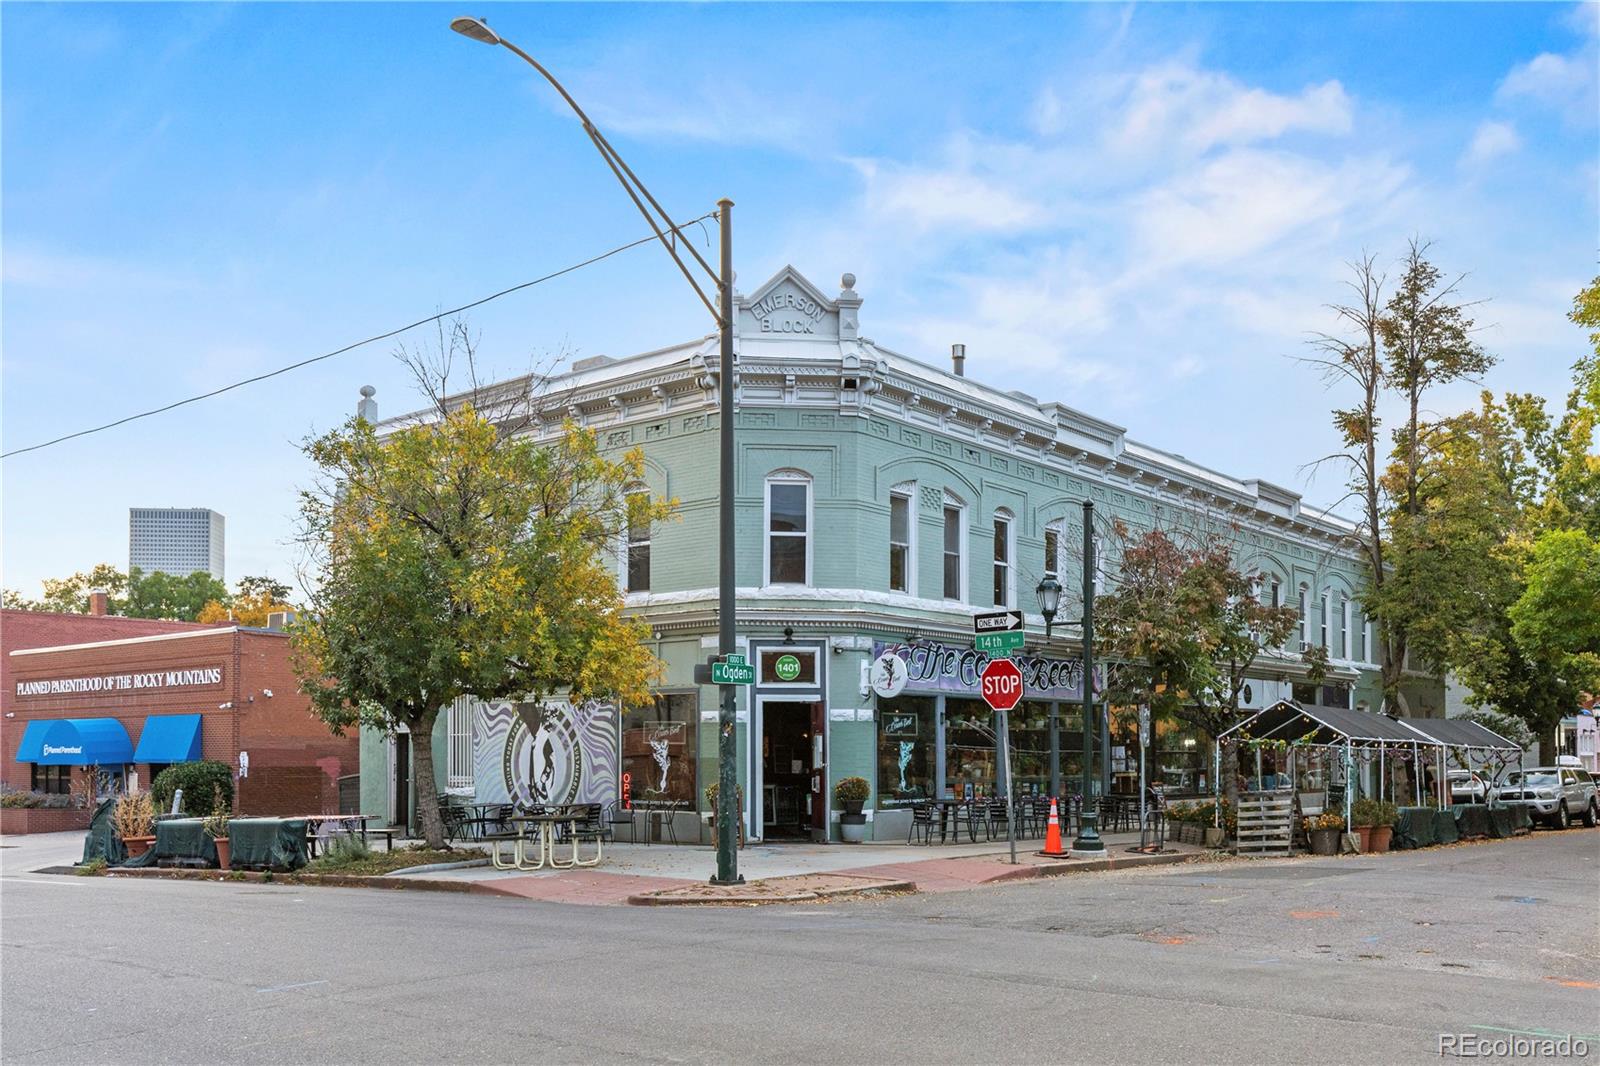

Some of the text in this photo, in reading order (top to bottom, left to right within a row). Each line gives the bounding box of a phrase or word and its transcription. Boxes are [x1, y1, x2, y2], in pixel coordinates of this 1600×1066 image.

[751, 293, 826, 323] EMERSON
[761, 318, 814, 334] BLOCK
[978, 617, 1007, 627] ONE WAY
[981, 636, 1002, 648] 14th
[723, 665, 748, 682] Ogden
[778, 664, 799, 672] 1401
[907, 643, 956, 681] The
[1027, 658, 1078, 690] Beet
[17, 668, 221, 696] PLANNED PARENTHOOD OF THE ROCKY MOUNTAINS
[984, 675, 1019, 695] STOP
